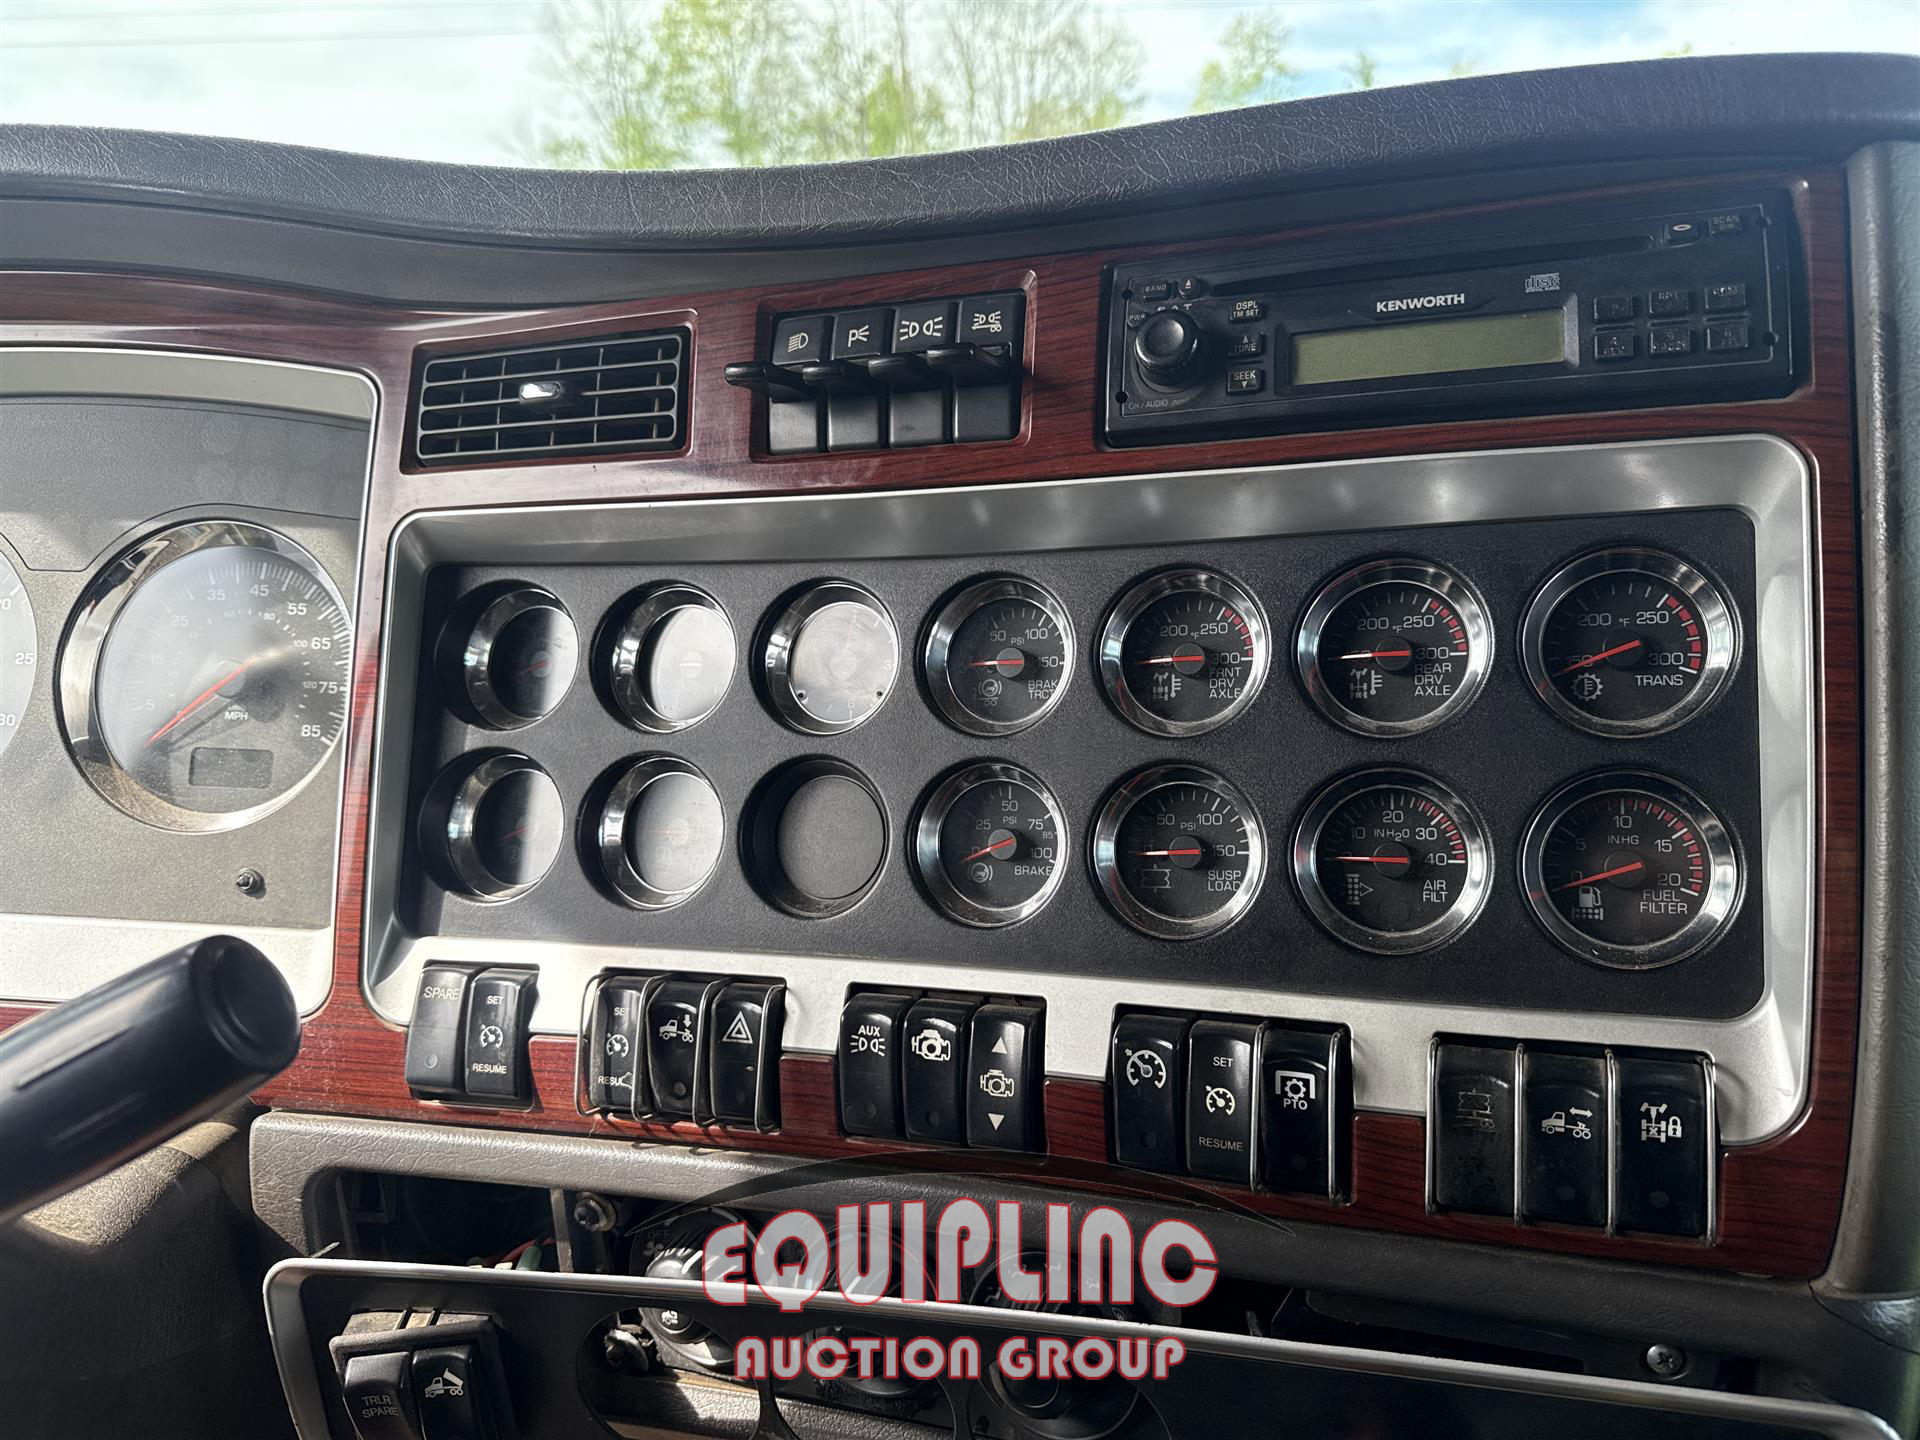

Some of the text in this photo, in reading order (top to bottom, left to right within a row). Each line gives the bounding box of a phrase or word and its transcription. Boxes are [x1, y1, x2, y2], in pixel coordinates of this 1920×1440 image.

[1236, 301, 1259, 310] DSPL
[1376, 293, 1466, 313] KENWORTH
[1233, 371, 1256, 381] SEEK
[207, 588, 227, 602] 35
[250, 583, 270, 598] 45
[0, 598, 12, 611] 0
[287, 602, 308, 616] 55
[1357, 617, 1389, 630] 200
[1403, 615, 1435, 628] 250
[1578, 613, 1611, 627] 200
[1636, 611, 1669, 624] 250
[1025, 627, 1048, 640] 100
[1160, 625, 1188, 637] 200
[1200, 622, 1228, 635] 250
[990, 630, 1007, 642] 50
[1011, 636, 1025, 646] PSI
[311, 636, 332, 651] 65
[15, 652, 34, 666] 25
[1212, 652, 1240, 665] 300
[1416, 646, 1449, 660] 300
[1648, 652, 1684, 666] 300
[1209, 667, 1241, 678] FRNT
[1415, 663, 1452, 674] REAR
[1209, 678, 1235, 688] DRV
[1415, 675, 1444, 686] DRV
[1635, 674, 1683, 687] TRANS
[318, 681, 339, 695] 75
[1209, 688, 1242, 699] AXLE
[1415, 686, 1452, 697] AXLE
[224, 710, 249, 721] MPH
[301, 724, 322, 738] 85
[1001, 800, 1019, 812] 50
[1002, 815, 1018, 825] PSI
[1157, 813, 1175, 826] 50
[1197, 813, 1223, 826] 100
[1382, 810, 1404, 823] 20
[1612, 815, 1632, 828] 10
[975, 819, 991, 830] 25
[1027, 818, 1044, 831] 75
[1180, 821, 1196, 831] PSI
[1042, 831, 1054, 840] 85
[1351, 826, 1366, 839] 10
[1415, 827, 1437, 840] 30
[1575, 837, 1586, 851] 5
[1654, 839, 1673, 853] 15
[1212, 845, 1236, 857] 150
[1425, 853, 1447, 866] 40
[1014, 865, 1053, 876] BRAKE
[1207, 869, 1242, 881] SUSP
[1207, 880, 1242, 892] LOAD
[1423, 879, 1446, 891] AIR
[1657, 873, 1682, 887] 20
[1423, 891, 1448, 903] FILT
[1643, 890, 1681, 902] FUEL
[1640, 901, 1688, 915] FILTER
[424, 986, 460, 1001] SPARE
[487, 995, 503, 1005] SET
[858, 1024, 881, 1037] AUX
[472, 1062, 508, 1074] RESUME
[1213, 1056, 1234, 1068] SET
[1283, 1098, 1308, 1111] PTO
[1199, 1137, 1243, 1151] RESUME
[362, 1395, 393, 1406] TRLR
[362, 1406, 399, 1418] SPARE
